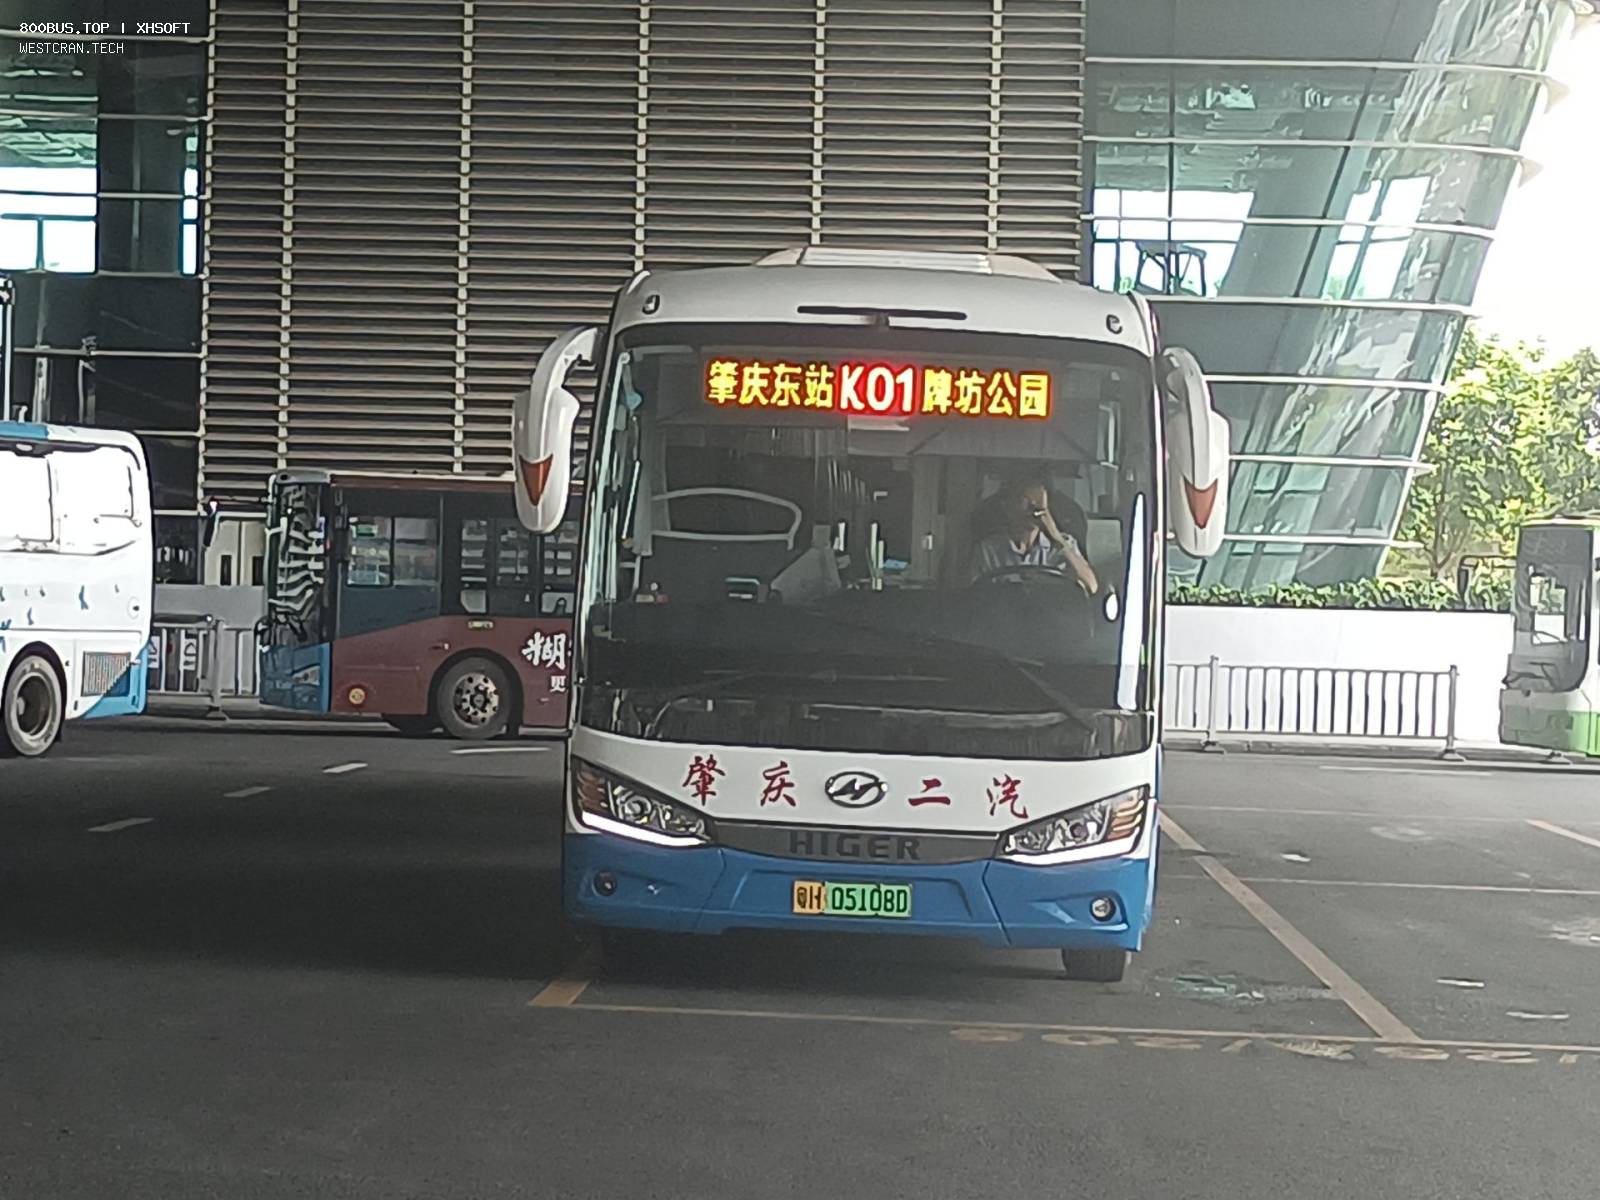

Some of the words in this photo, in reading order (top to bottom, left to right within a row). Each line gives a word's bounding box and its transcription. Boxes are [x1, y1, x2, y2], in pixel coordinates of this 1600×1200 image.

[708, 360, 835, 408] 肇庆东站
[840, 364, 915, 413] K01
[921, 368, 1049, 417] 牌坊公园
[521, 631, 572, 671] 糊
[789, 831, 921, 860] HIGER
